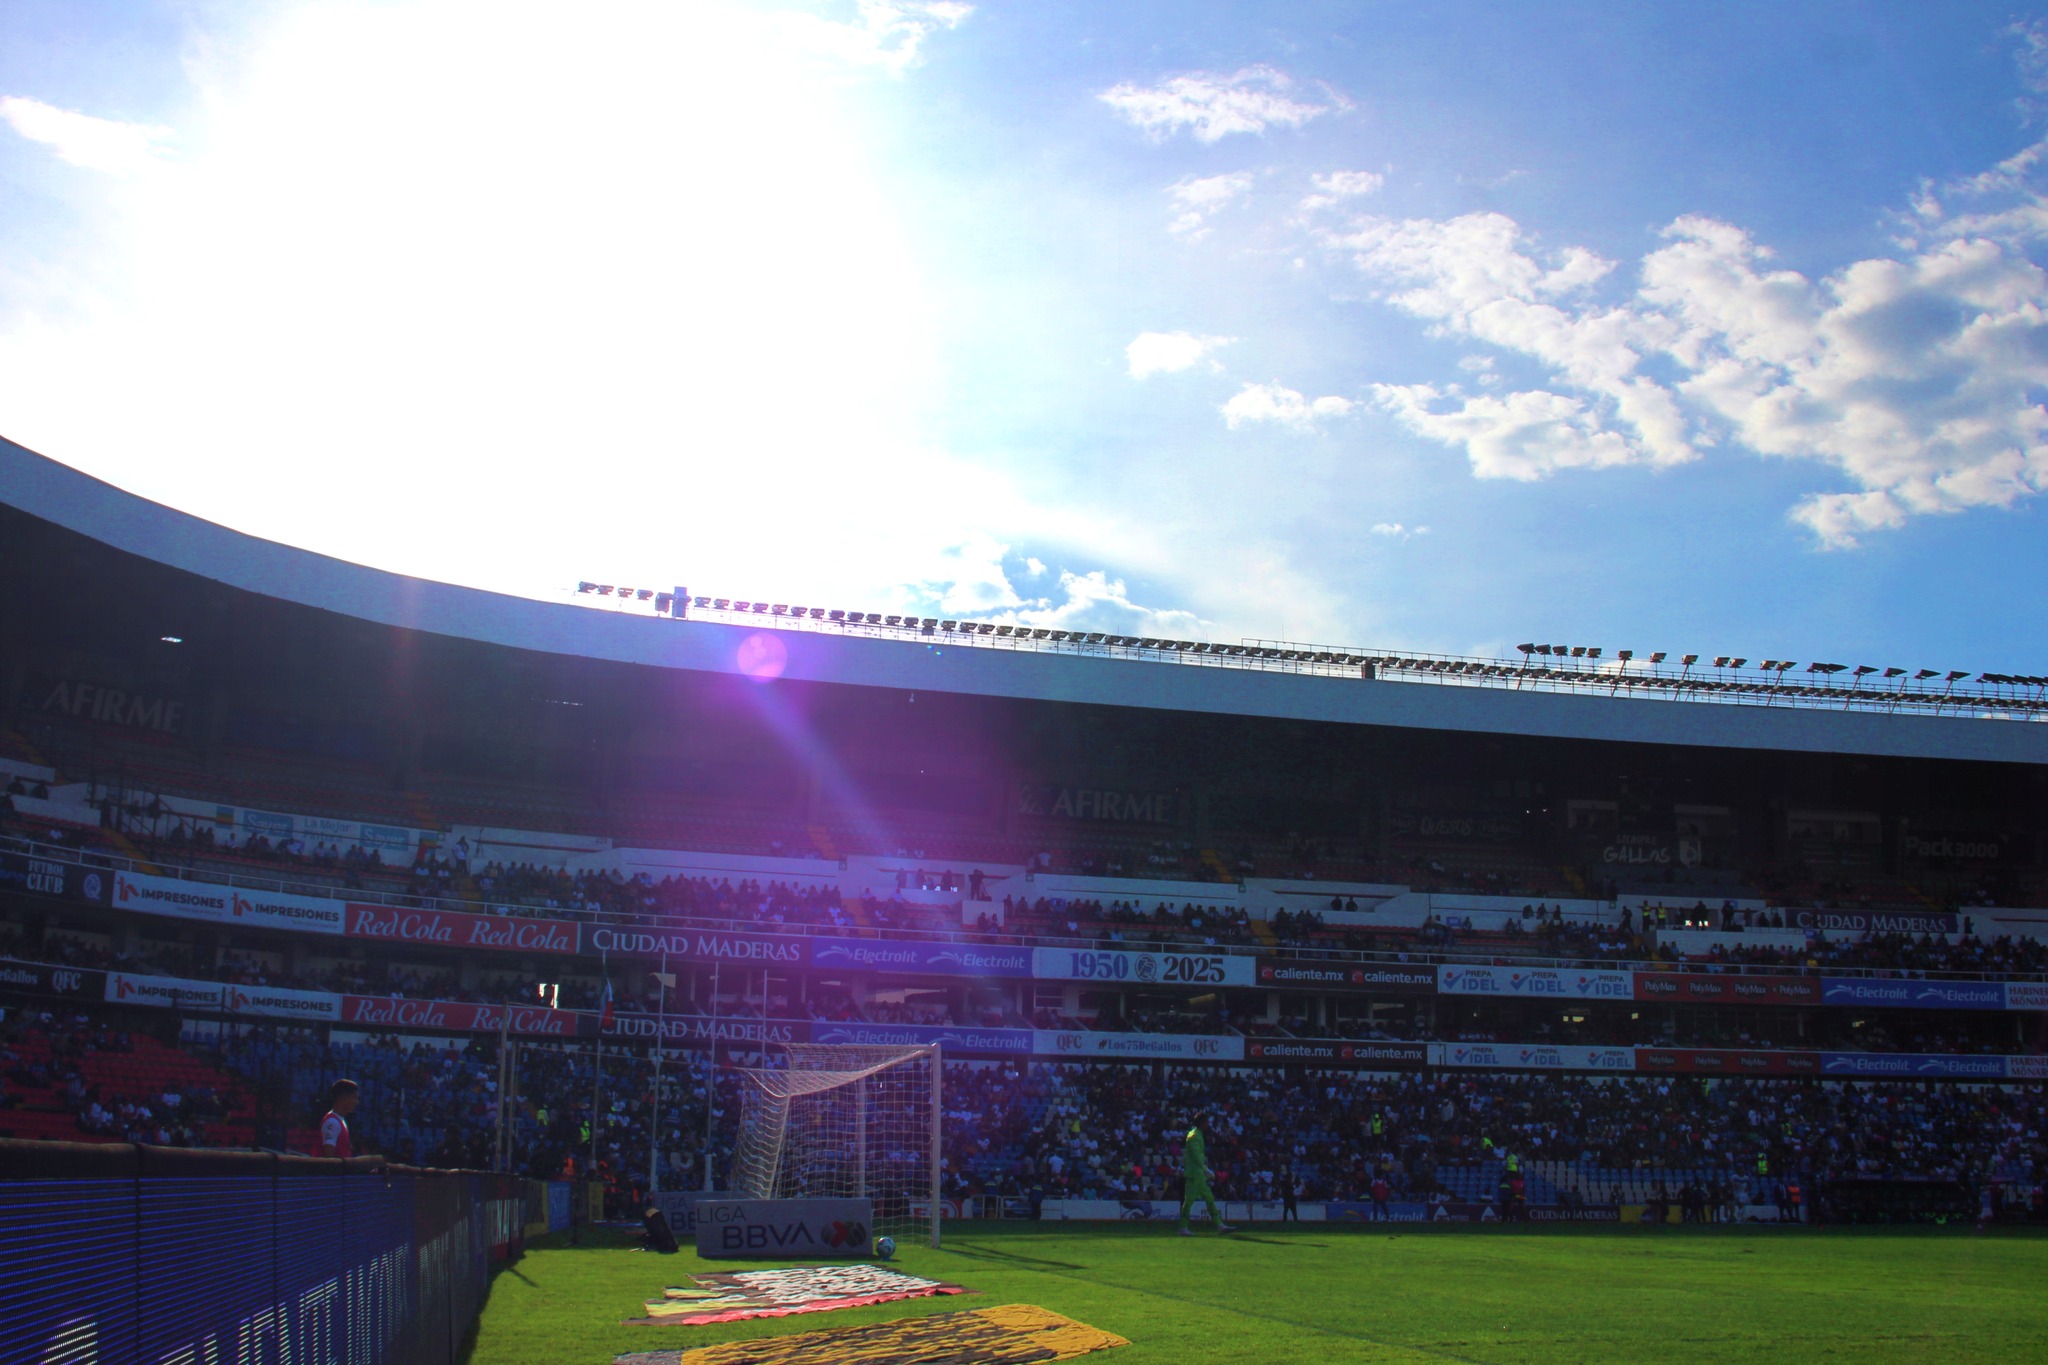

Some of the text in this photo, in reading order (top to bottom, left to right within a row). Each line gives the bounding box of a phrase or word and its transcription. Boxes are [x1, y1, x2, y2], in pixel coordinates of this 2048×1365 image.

[42, 681, 183, 732] AFIRME
[1051, 789, 1169, 823] AFIRME
[1904, 836, 1999, 858] Pack3000
[28, 860, 65, 877] FUTBOL
[26, 873, 64, 895] CLUB
[141, 887, 339, 922] IMPRESIONES IMPRESIONES
[1797, 912, 1947, 933] CUDAD MADERAS
[592, 929, 800, 962] CIUDAD MADERAS
[853, 947, 1025, 969] Electrolit Electrolit
[1069, 952, 1226, 983] 1950 2025
[1274, 967, 1433, 985] caliente.mx caliente.mx
[1465, 970, 1492, 978] PREPA
[1532, 972, 1558, 980] PREPA
[52, 970, 82, 993] QFC
[1462, 978, 1500, 991] IDEL
[1529, 980, 1566, 993] IDEL
[1598, 975, 1625, 983] PREPA
[137, 985, 334, 1012] IMPRESIONES IMPRESIONES
[1595, 983, 1632, 996] IDEL
[1855, 986, 1999, 1002] Electrolit Electrolit
[694, 1020, 793, 1043] MADERAS
[855, 1030, 1029, 1050] Electrolit Electrolit
[1056, 1034, 1083, 1051] QFC
[1193, 1038, 1220, 1056] QFC
[1263, 1043, 1423, 1060] caliente.mx caliente.mx
[1469, 1054, 1499, 1065] IDEL
[1534, 1055, 1564, 1066] IDEL
[1602, 1057, 1632, 1068] IDEL
[1856, 1058, 2001, 1073] Electrolit Electrolit
[697, 1206, 747, 1224] LIGA
[1529, 1208, 1570, 1221] CIUDAD
[1573, 1208, 1618, 1221] MADERAS
[722, 1221, 815, 1249] BBVA
